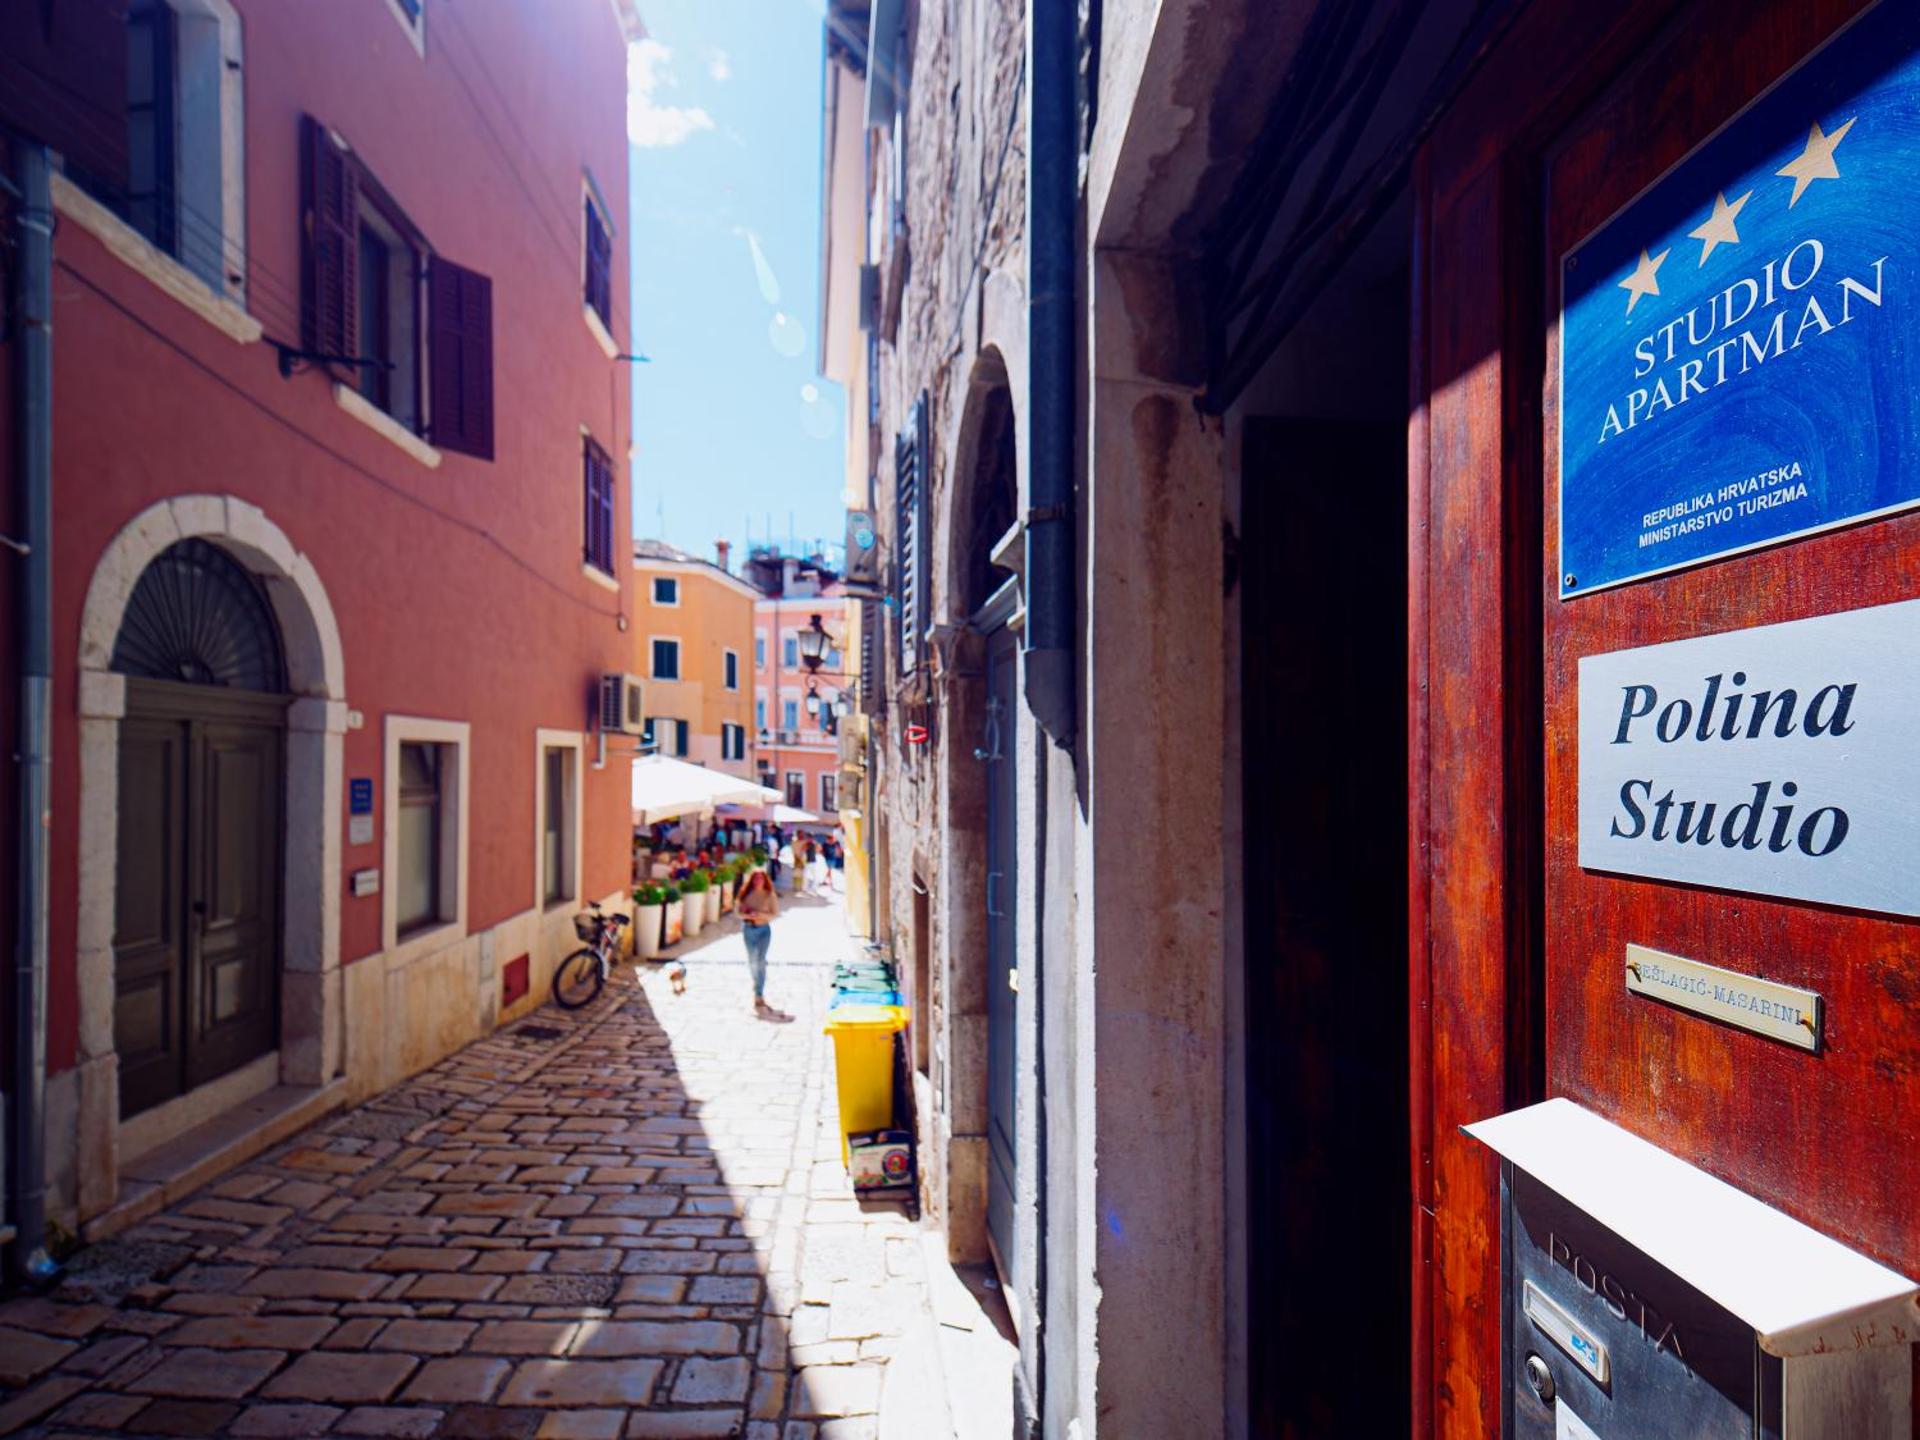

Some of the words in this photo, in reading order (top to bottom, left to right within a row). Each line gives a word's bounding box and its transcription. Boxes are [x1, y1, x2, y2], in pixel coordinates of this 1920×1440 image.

[1634, 239, 1824, 379] STUDIO
[1598, 255, 1889, 444] APARTMAN
[1638, 506, 1733, 549] MINISTARSTVO
[1737, 482, 1808, 516] TURIZMA
[1642, 493, 1715, 528] REPUBLIKA
[1717, 461, 1802, 504] HRVATSKA
[1610, 671, 1858, 744] Polina
[1610, 779, 1850, 857] Studio
